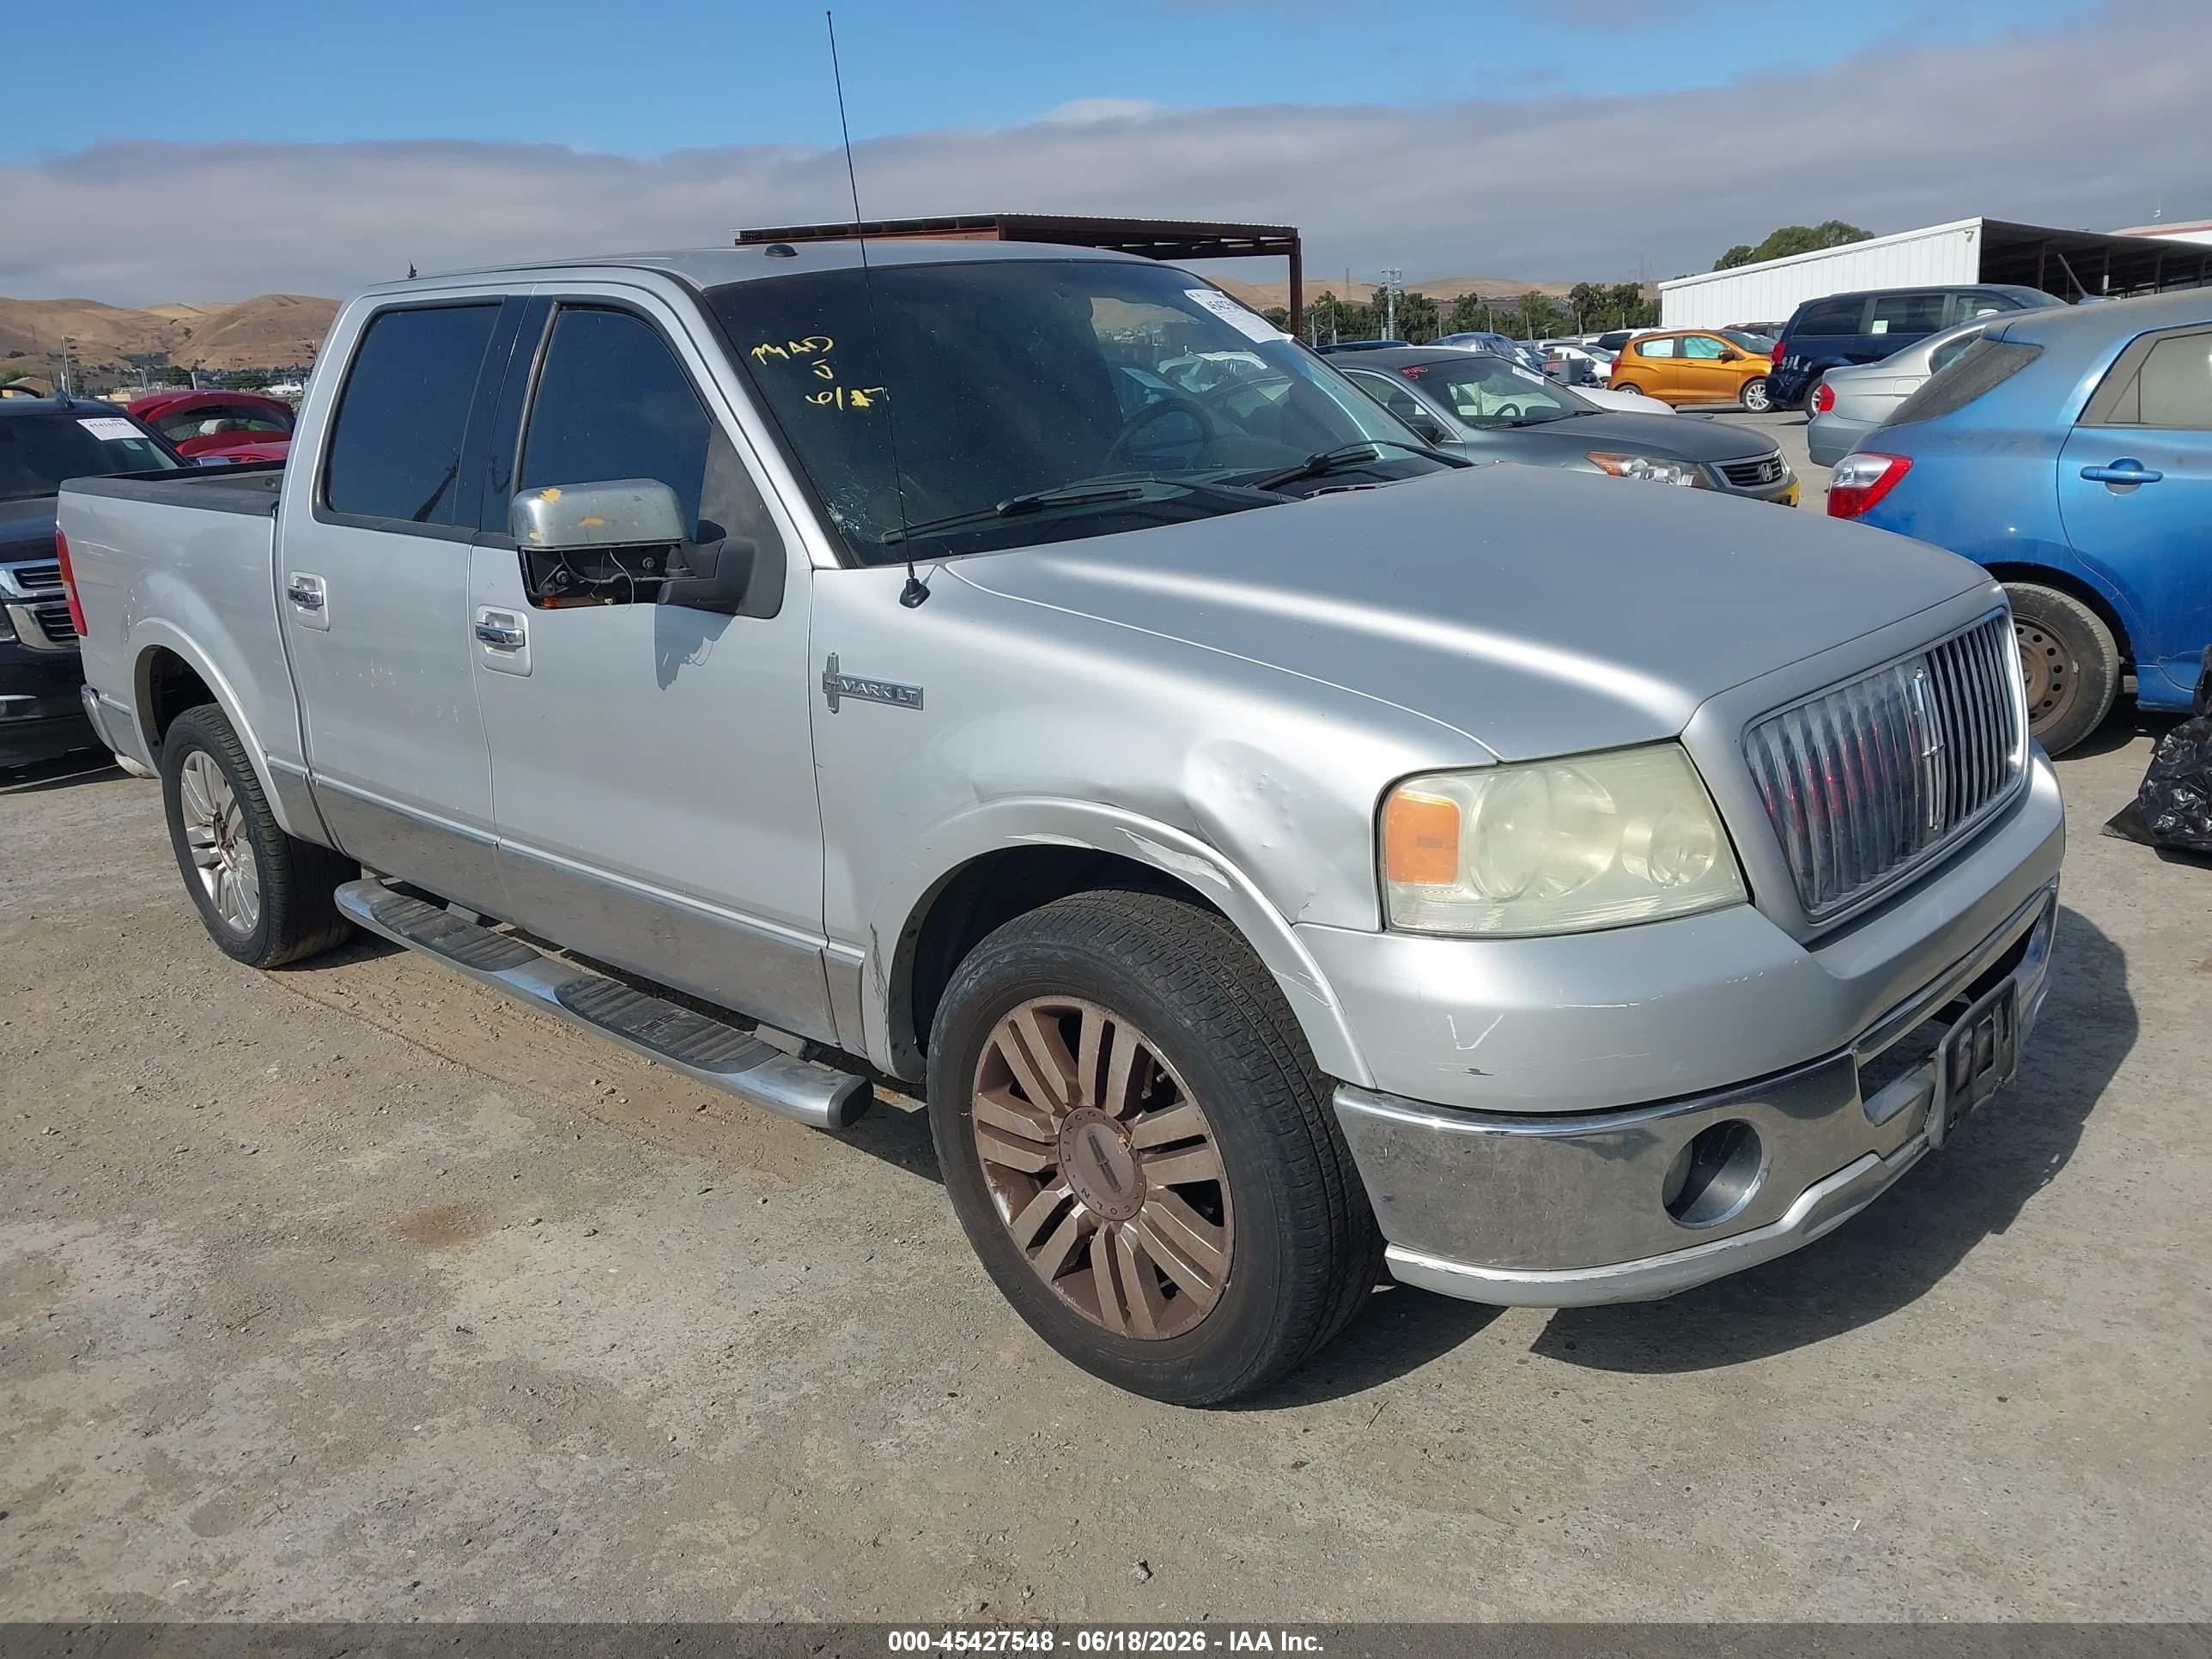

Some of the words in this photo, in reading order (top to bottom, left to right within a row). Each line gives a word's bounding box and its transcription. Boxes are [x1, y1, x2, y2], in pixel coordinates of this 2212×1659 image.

[750, 336, 835, 366] MAD
[805, 386, 890, 411] 6/7
[842, 680, 891, 698] MARK
[897, 689, 917, 702] LT
